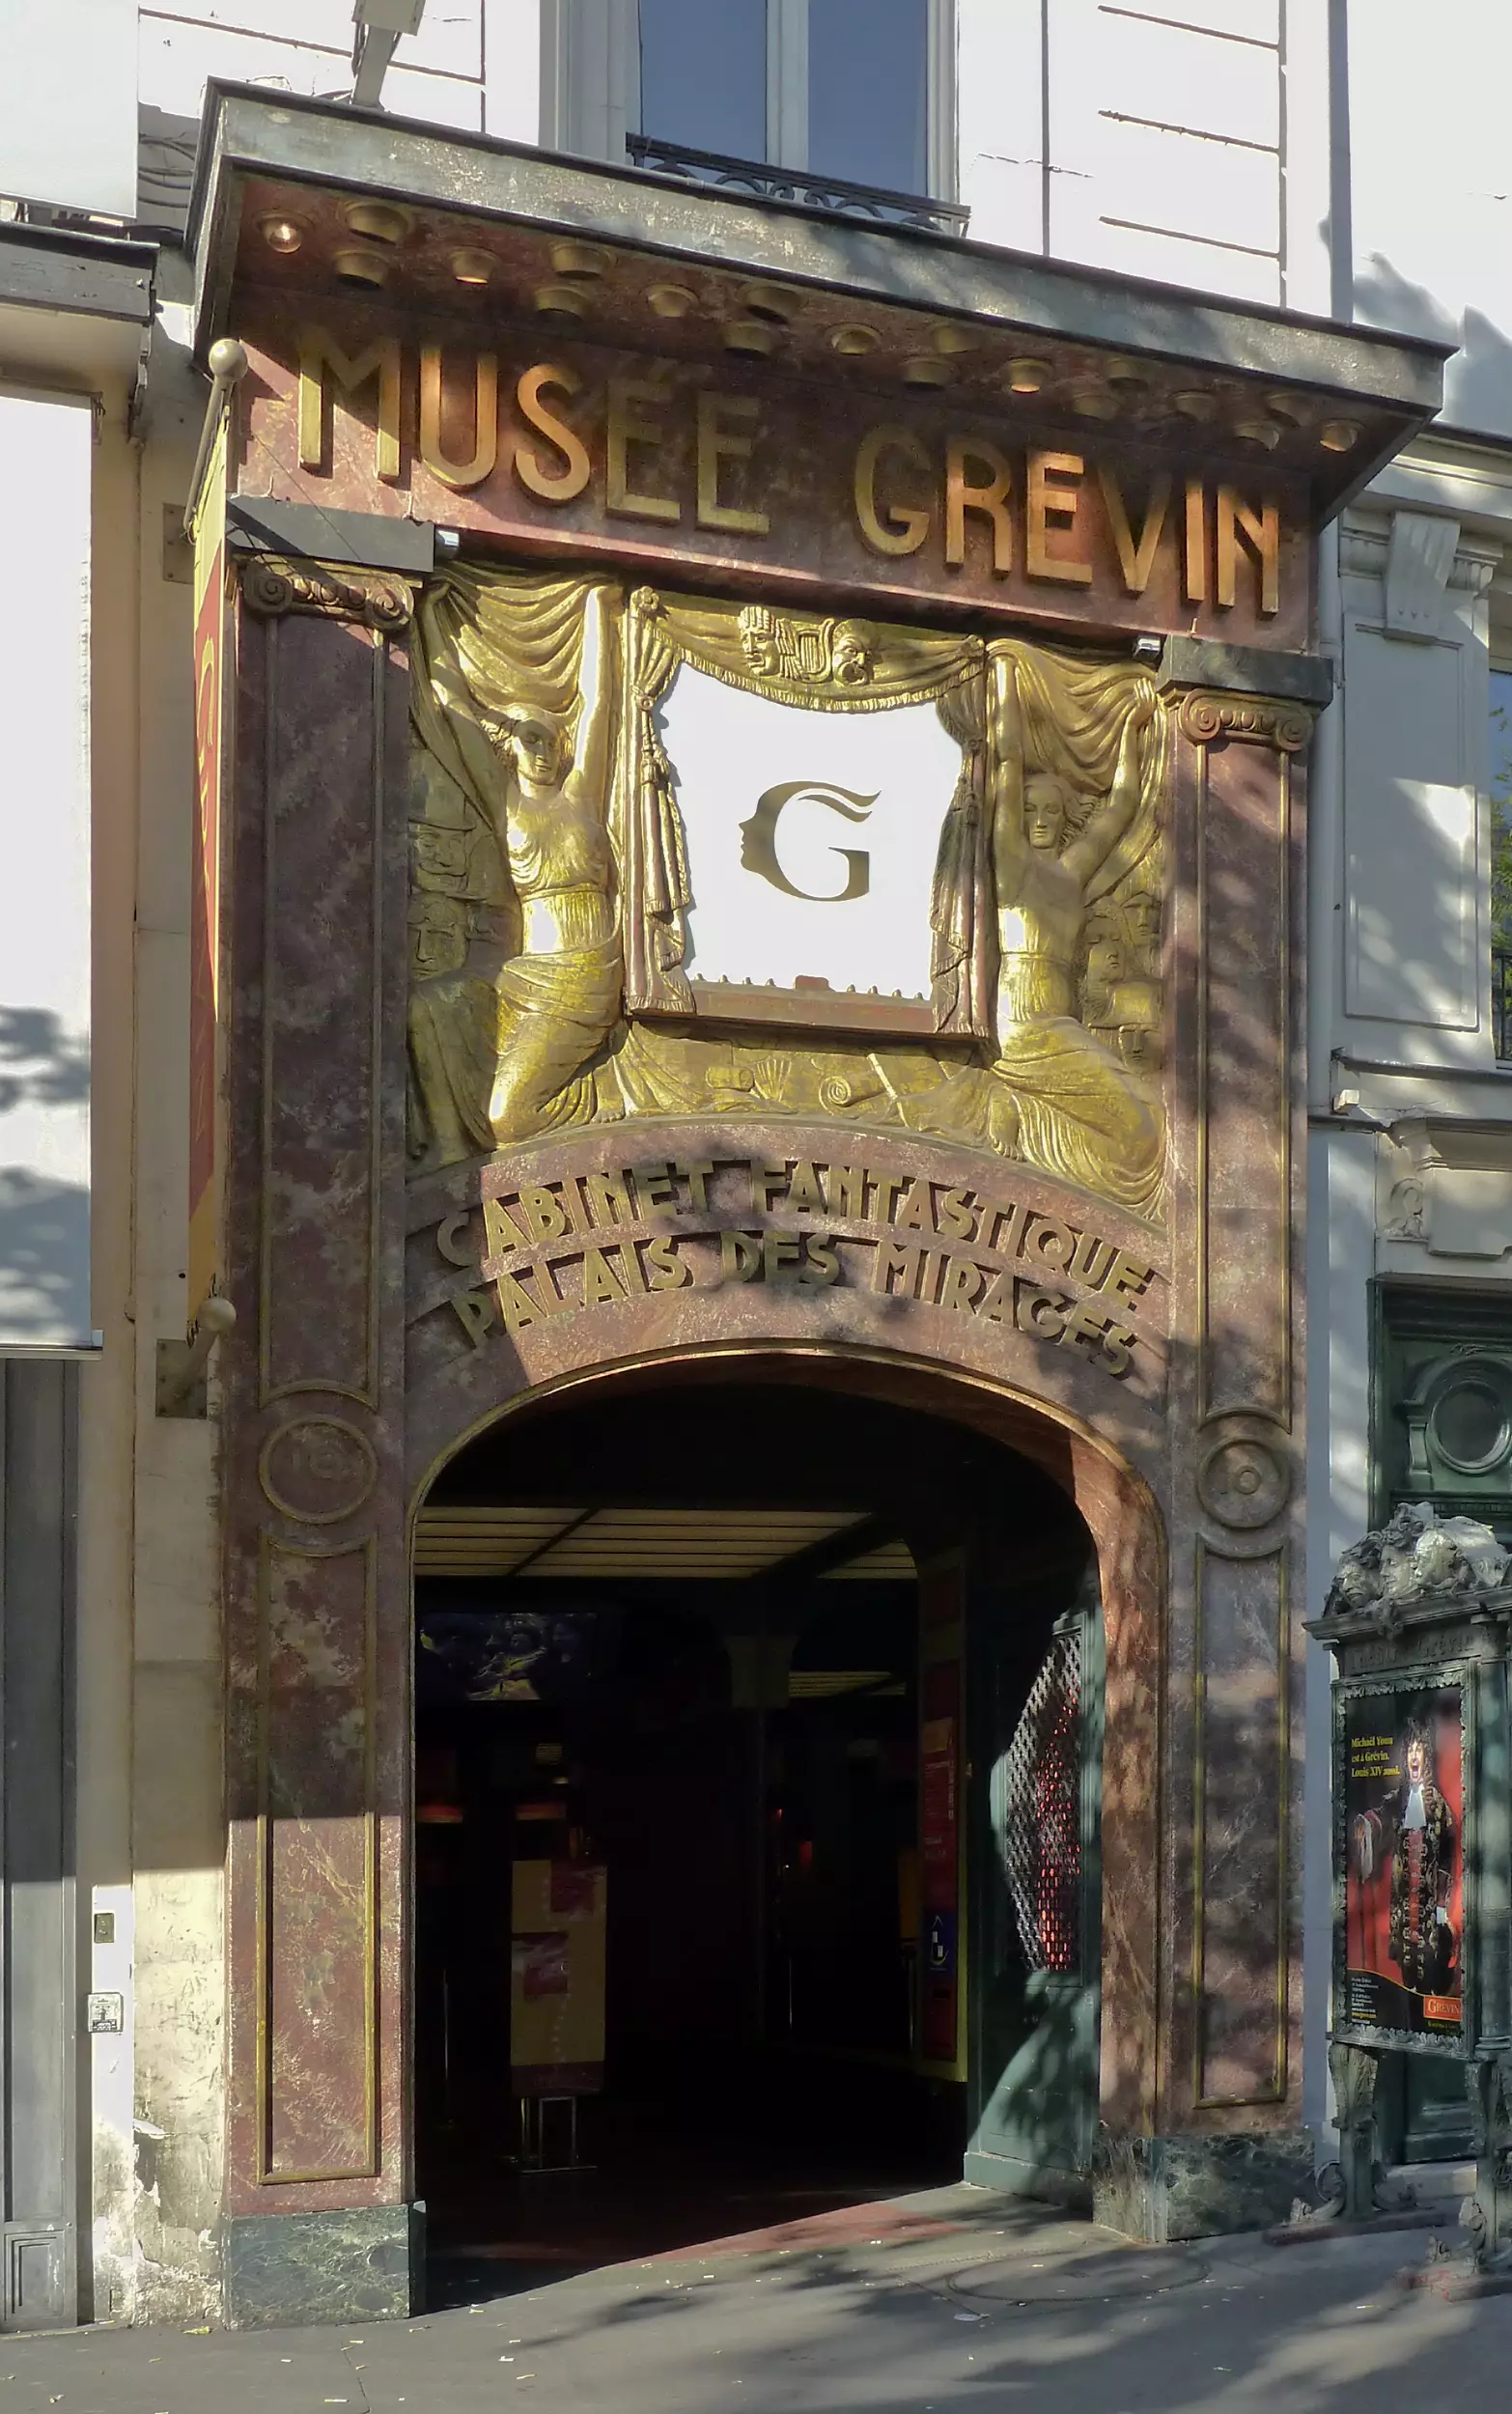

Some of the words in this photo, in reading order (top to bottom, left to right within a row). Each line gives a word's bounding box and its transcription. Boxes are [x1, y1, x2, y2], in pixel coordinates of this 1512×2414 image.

[854, 425, 1279, 612] GREVIN
[739, 780, 882, 902] G
[436, 1161, 714, 1267] CABINET
[751, 1159, 1155, 1310] FANTASTIQUE
[451, 1235, 690, 1349] PALAIS
[721, 1231, 840, 1286] DES
[872, 1239, 1134, 1375] MIRAGES
[1352, 1766, 1369, 1777] Louis
[1370, 1765, 1383, 1777] XIV
